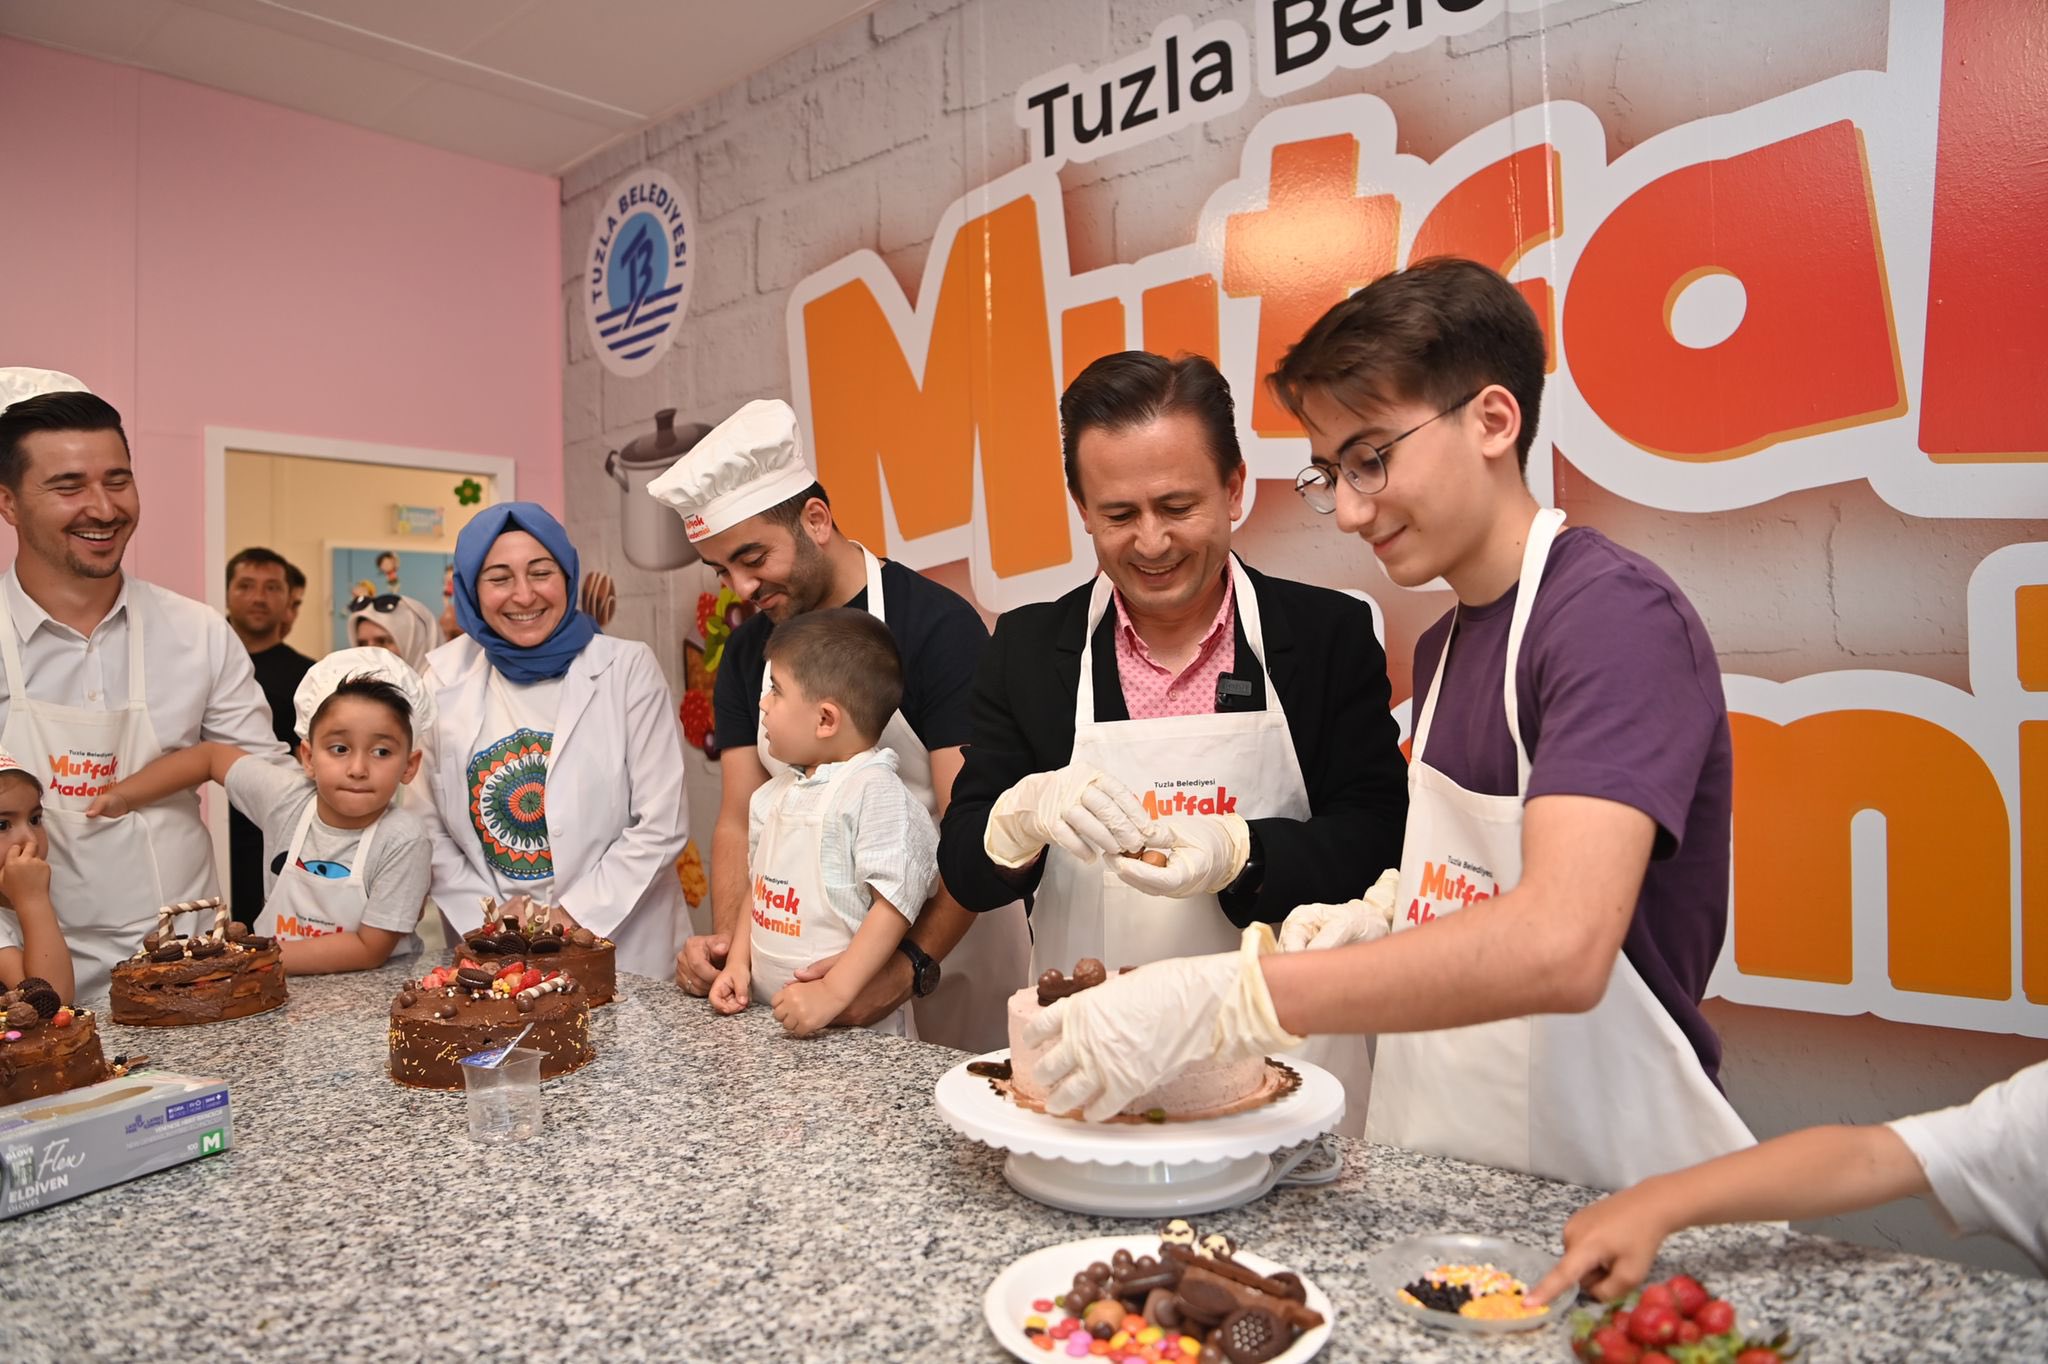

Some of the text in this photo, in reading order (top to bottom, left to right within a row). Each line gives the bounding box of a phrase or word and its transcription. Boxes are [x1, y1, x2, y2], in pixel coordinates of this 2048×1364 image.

[1027, 0, 1485, 158] Tuzla Be
[592, 215, 618, 304] TUZLA
[1134, 786, 1237, 820] Mutfak
[1176, 778, 1216, 787] Belediyesi
[755, 874, 800, 915] Mtfak
[1420, 862, 1499, 908] Mutf
[38, 1137, 85, 1180] Flex
[203, 1132, 220, 1152] M
